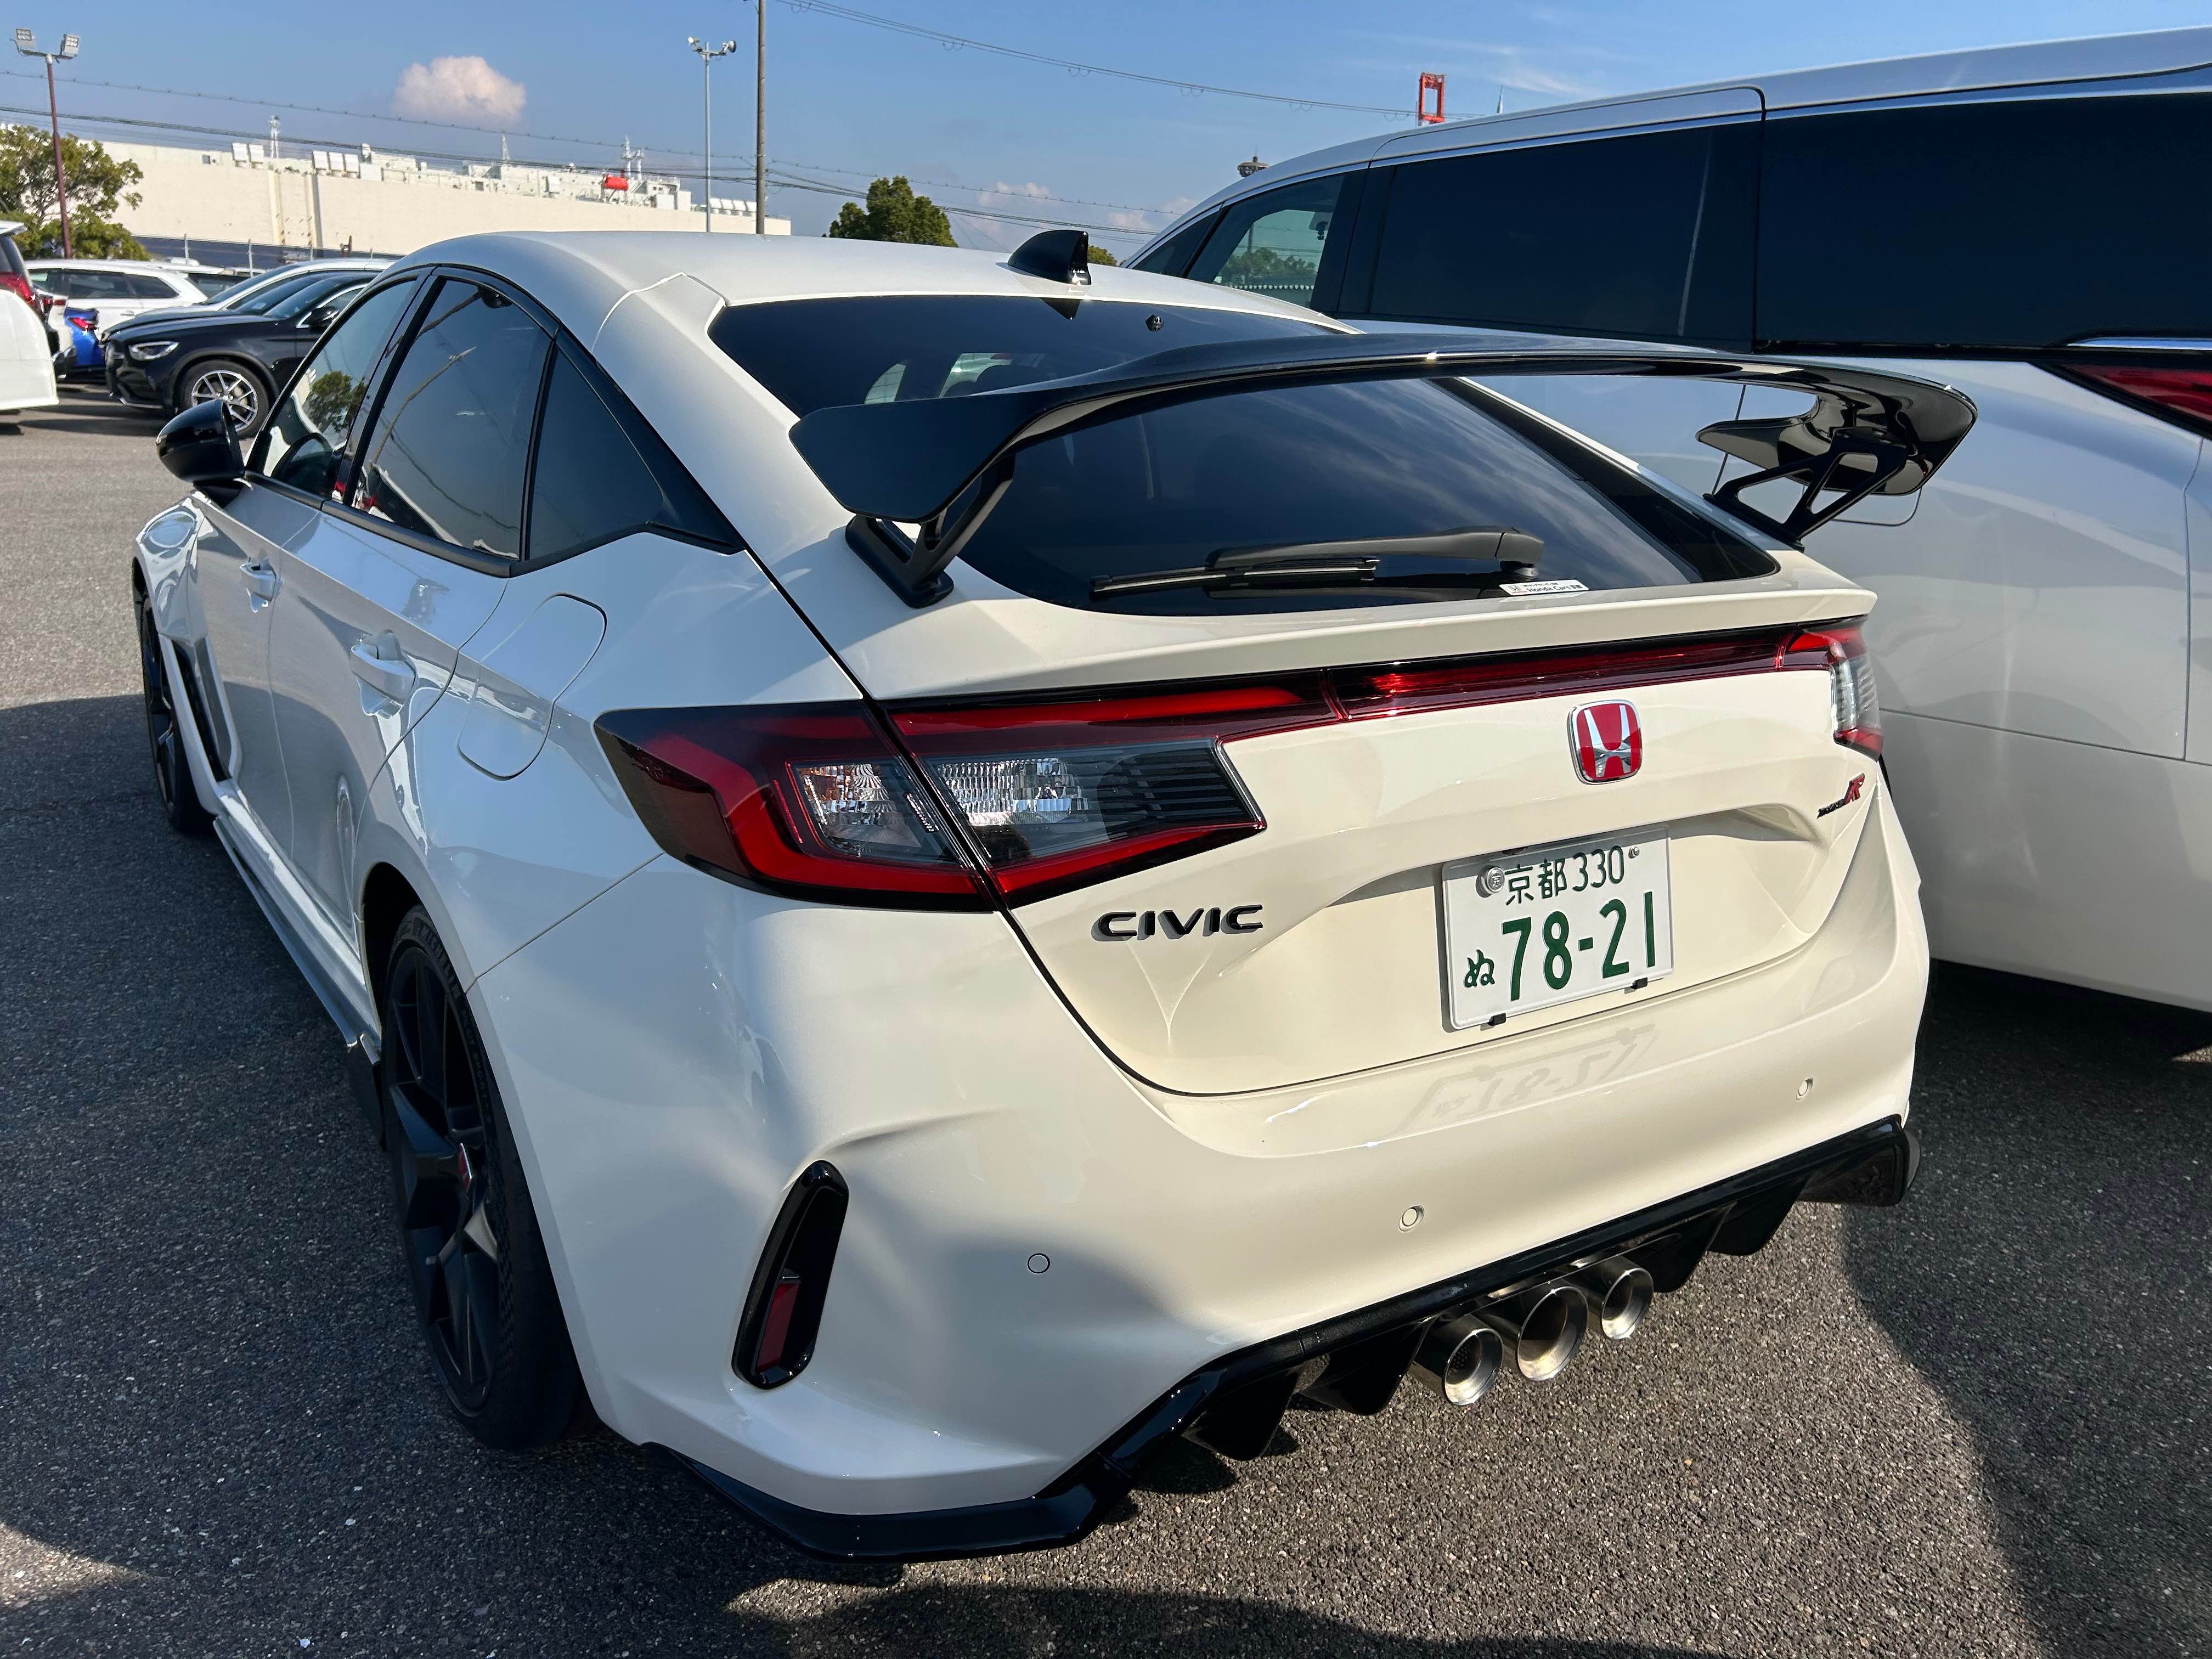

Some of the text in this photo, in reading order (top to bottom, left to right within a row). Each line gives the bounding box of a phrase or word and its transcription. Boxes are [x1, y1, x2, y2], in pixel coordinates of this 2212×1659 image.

[1099, 904, 1263, 937] CIVIC
[1502, 891, 1656, 1002] 78-21
[1464, 949, 1496, 988] ぬ
